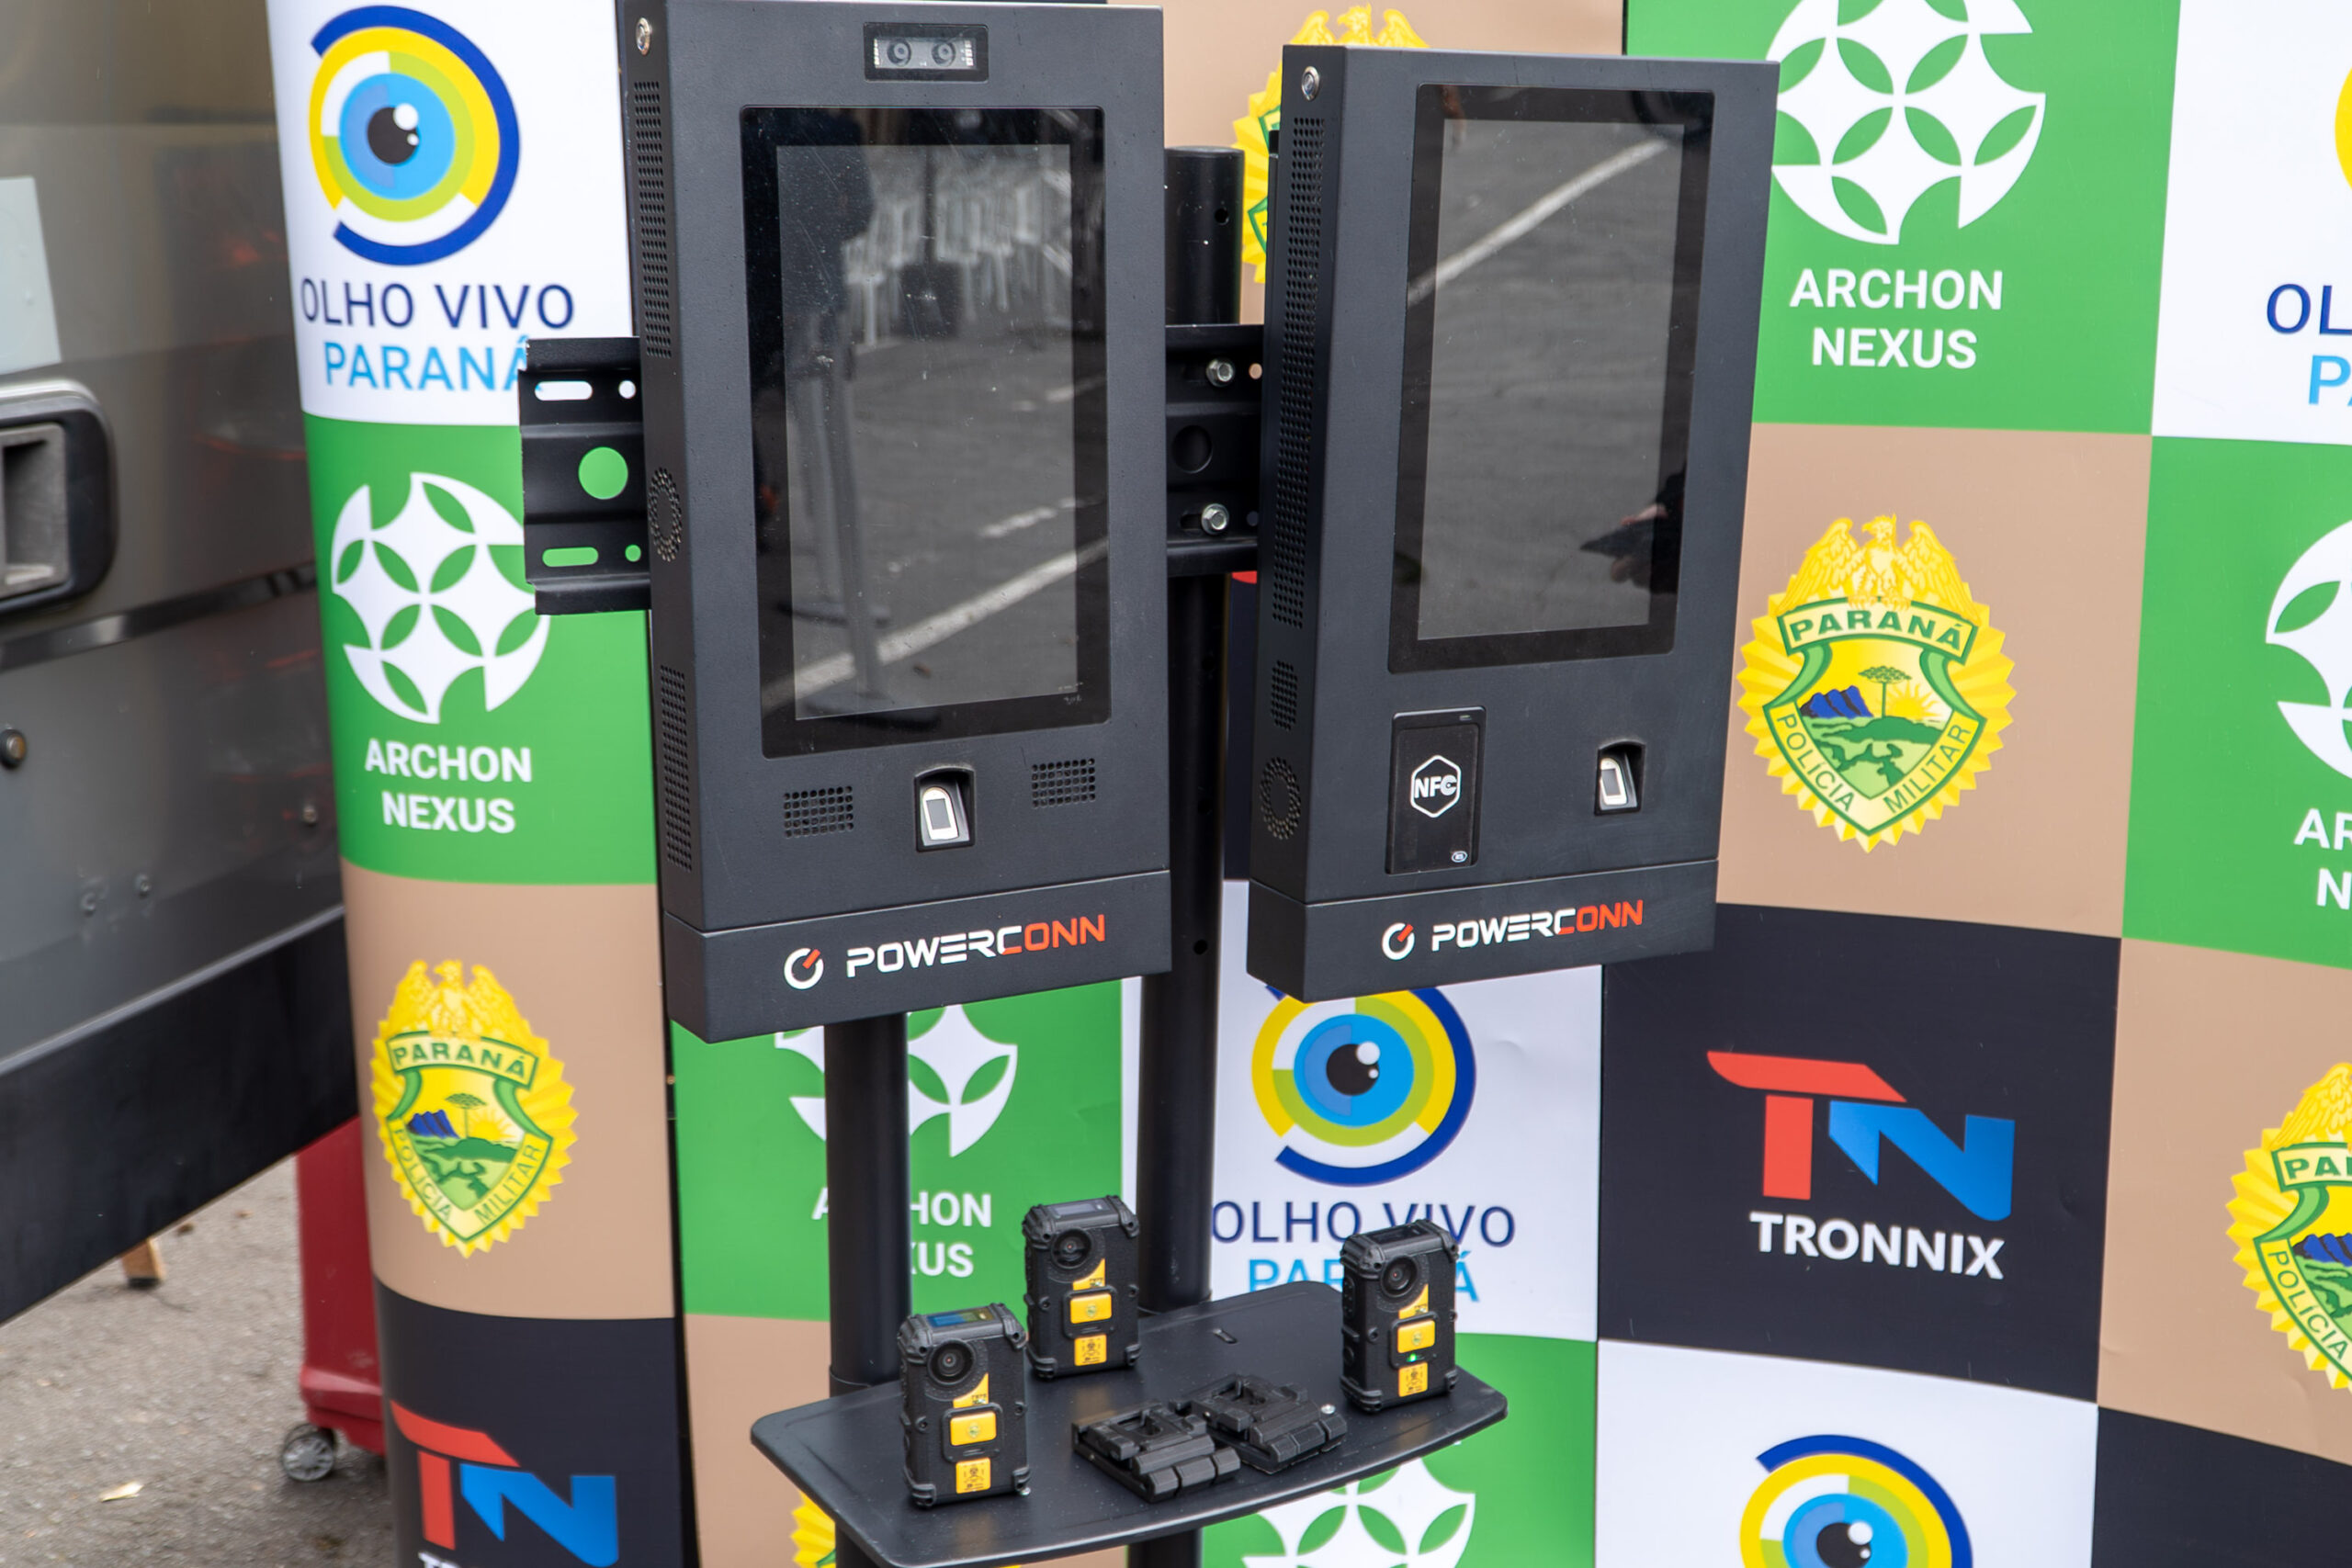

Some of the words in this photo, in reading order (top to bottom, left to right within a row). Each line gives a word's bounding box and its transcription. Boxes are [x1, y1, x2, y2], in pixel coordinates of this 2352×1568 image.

[301, 277, 414, 328] OLHO
[434, 283, 575, 329] VIVO
[1789, 268, 2003, 310] ARCHON
[1812, 327, 1978, 369] NEXUS
[1788, 609, 1962, 651] PARANÁ
[365, 738, 532, 783] ARCHON
[1883, 724, 1972, 815] MILITAR
[1414, 774, 1458, 799] NFC
[381, 790, 516, 834] NEXUS
[846, 913, 1106, 978] POWERCONN
[1431, 899, 1644, 952] POWERCONN
[392, 1041, 528, 1078] PARANÁ
[473, 1144, 541, 1225] MILITAR
[811, 1187, 992, 1227] AHON
[1212, 1201, 1362, 1243] OLHO
[1749, 1211, 2006, 1280] TRONNIX
